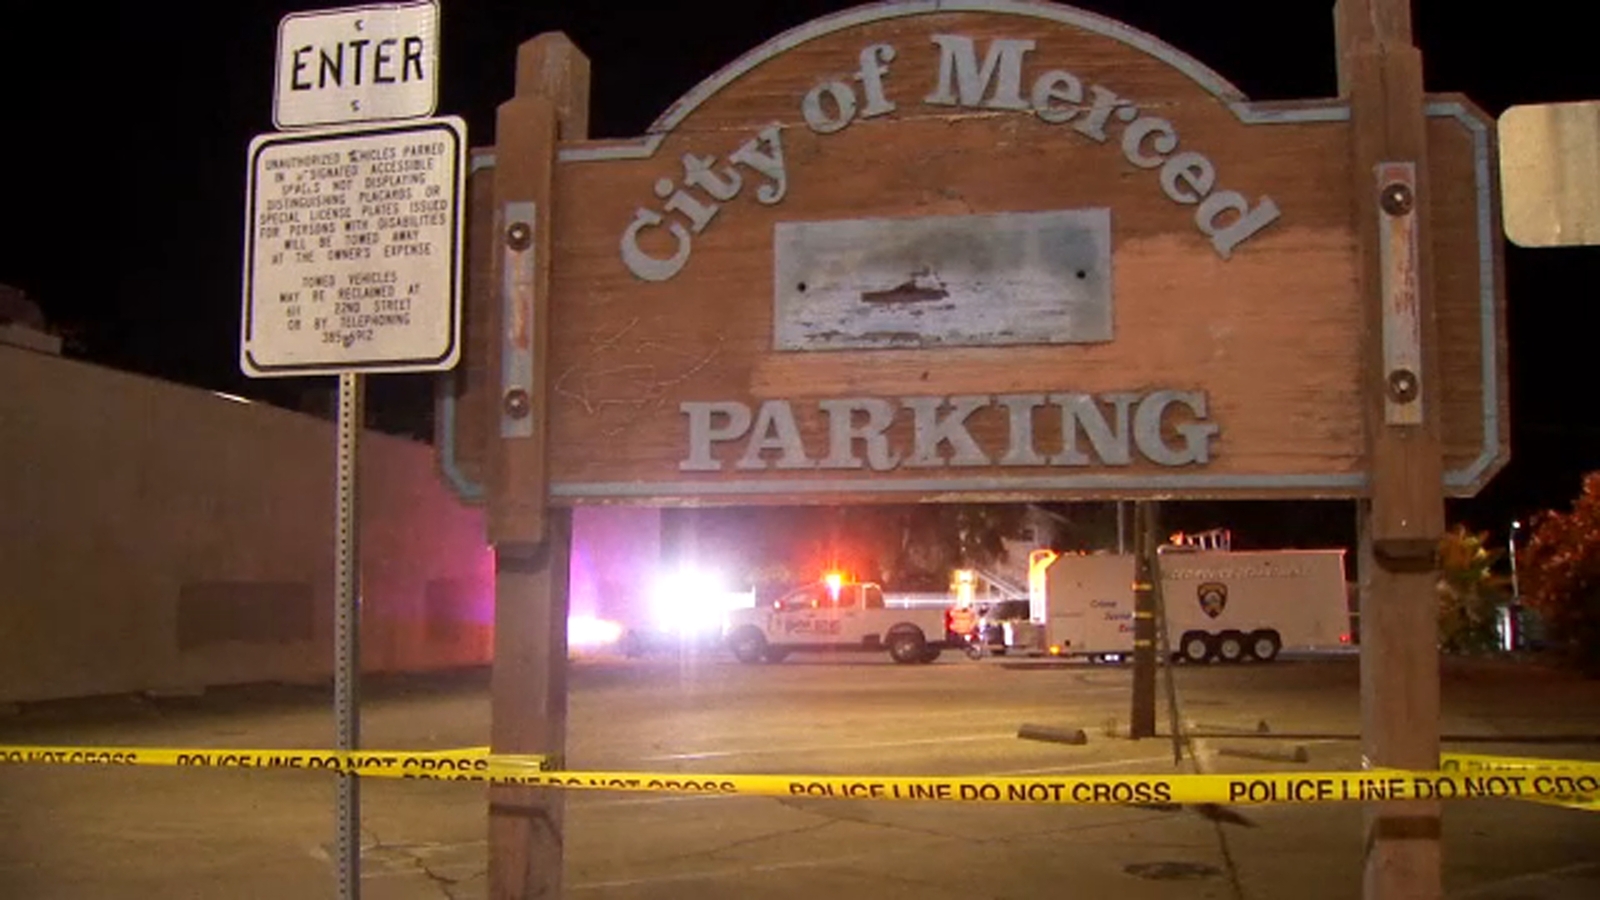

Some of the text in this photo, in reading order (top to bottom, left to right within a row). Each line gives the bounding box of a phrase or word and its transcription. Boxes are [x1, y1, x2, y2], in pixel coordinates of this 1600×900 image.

[291, 36, 424, 91] ENTER
[265, 143, 444, 171] UNAUTHORIZED EHICLES PARKED
[621, 34, 1281, 282] City of Merced
[275, 157, 435, 183] IN SIGNATED ACCESSIBLE
[332, 180, 352, 191] NOT
[365, 173, 427, 189] DISPLAYING
[267, 185, 441, 211] DISTINGUISHING PLACARDS OR
[260, 199, 449, 226] SPECIAL LICENSE PLATES ISSUED
[260, 213, 446, 238] FOR PERSONS WITH DISABILITIES
[272, 252, 284, 264] AT
[295, 251, 314, 263] THE
[384, 242, 432, 258] EXPENSE
[284, 230, 420, 251] WILL BE TOWED AWAY
[302, 271, 398, 288] TOWED VEHICLES
[280, 283, 420, 303] MAY BE RECLAIMED AT
[334, 302, 361, 315] 22ND
[374, 298, 412, 313] STREET
[287, 312, 411, 332] OR BY TELEPHONING
[679, 389, 1221, 472] PARKING
[789, 781, 1172, 802] POLICE LINE DO NOT CROSS
[1228, 779, 1334, 803] POLICE
[1340, 778, 1406, 802] LINE
[1414, 777, 1459, 801] DO
[1464, 776, 1526, 799] NOT
